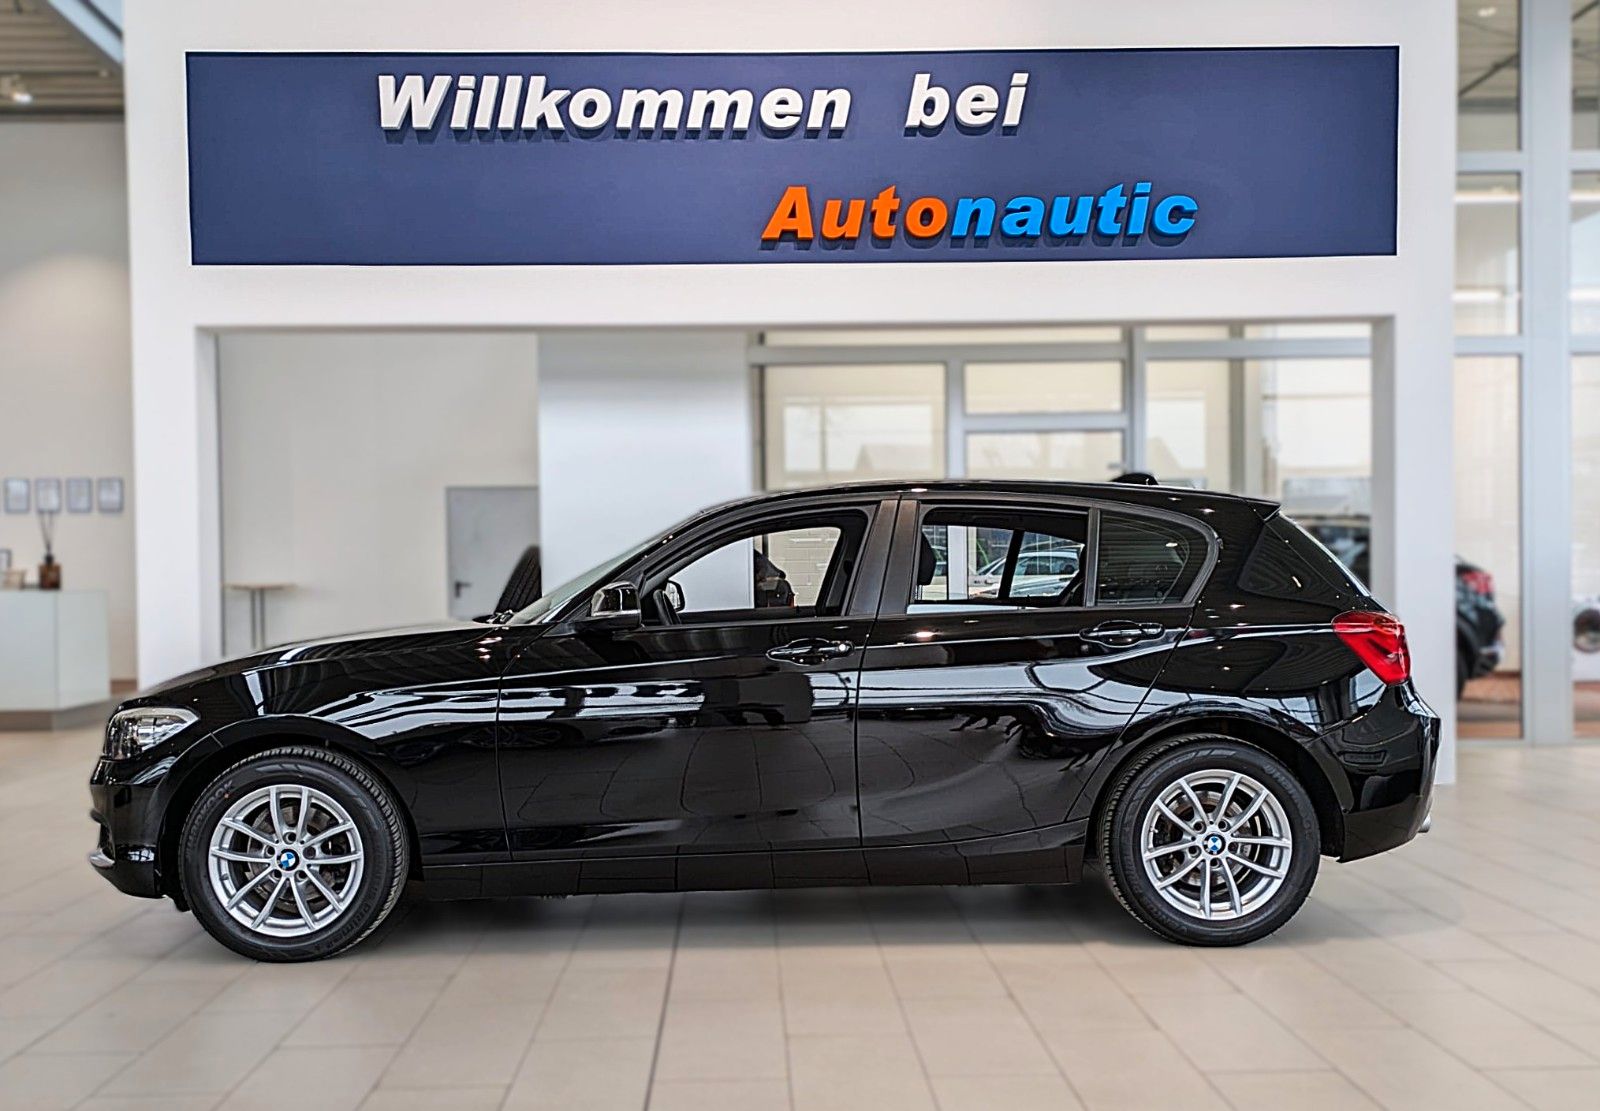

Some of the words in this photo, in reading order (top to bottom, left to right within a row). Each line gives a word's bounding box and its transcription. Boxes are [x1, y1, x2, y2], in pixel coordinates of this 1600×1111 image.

[377, 74, 852, 131] Willkommen
[905, 72, 1029, 128] bei
[762, 181, 1199, 242] Autonautic
